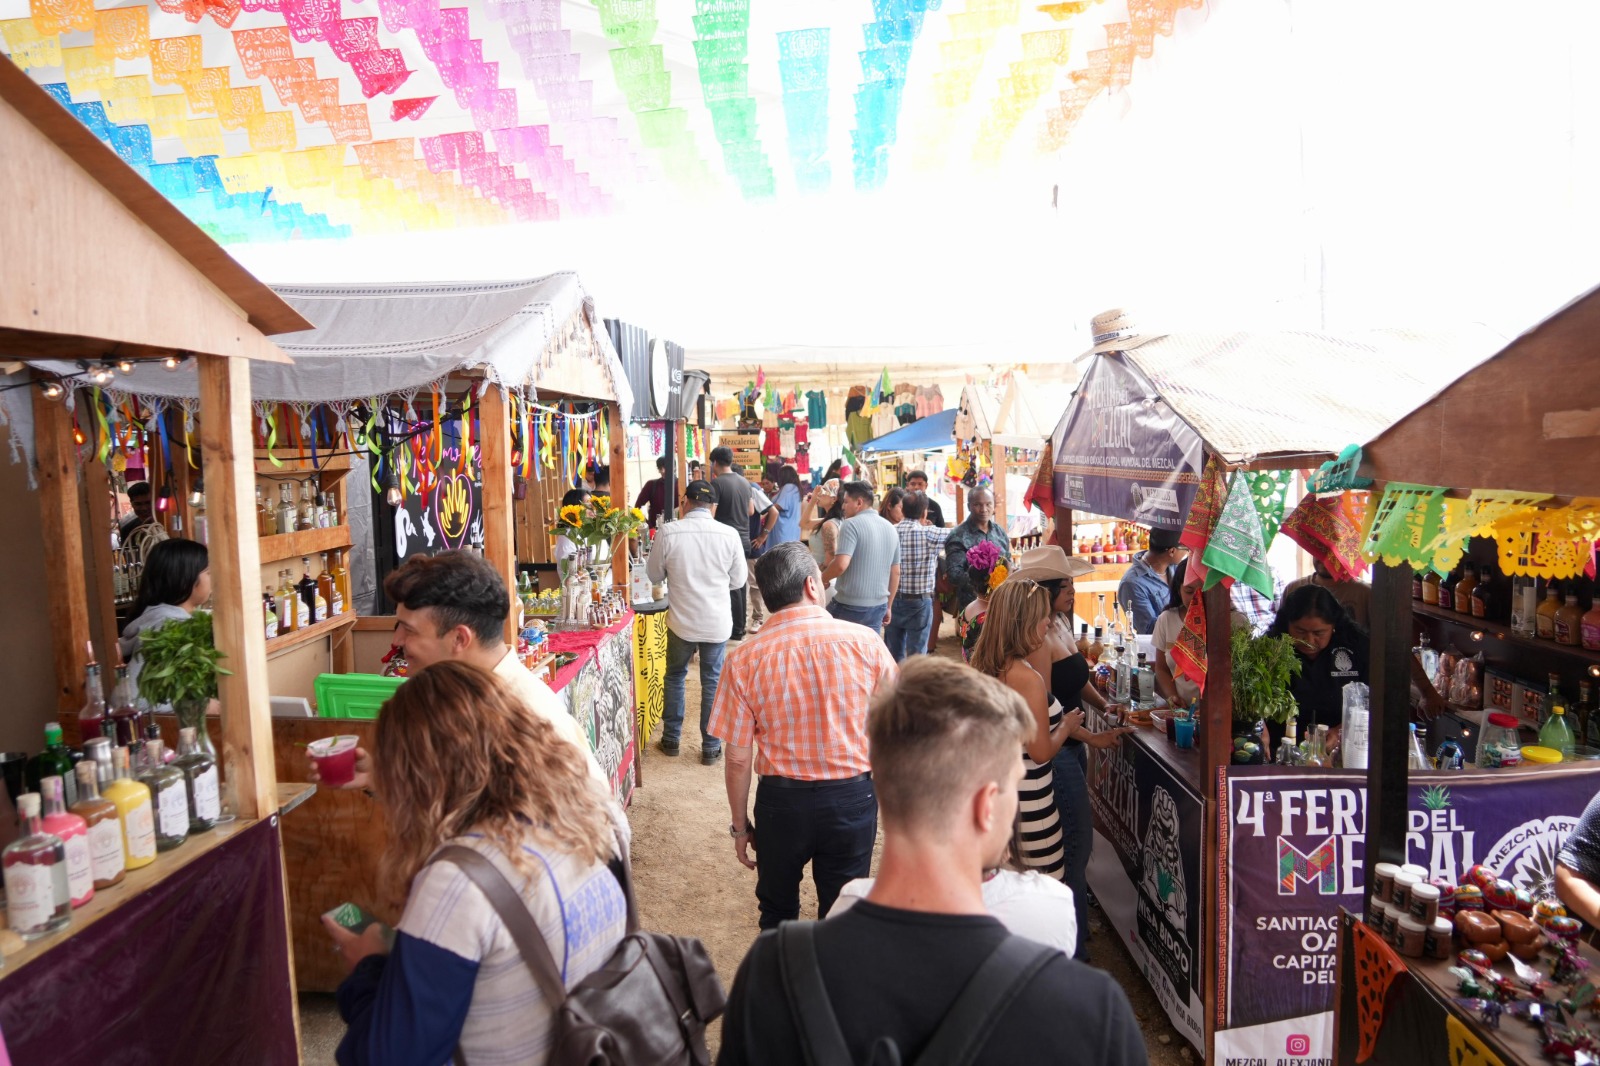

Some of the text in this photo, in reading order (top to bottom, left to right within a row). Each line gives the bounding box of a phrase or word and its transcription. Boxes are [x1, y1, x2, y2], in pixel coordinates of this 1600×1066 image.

[1141, 458, 1152, 468] DEL
[1152, 457, 1176, 469] MEZCAL
[1279, 788, 1368, 836] FERI
[1408, 809, 1465, 832] DEL
[1489, 822, 1576, 870] MEZCAL ART
[1256, 916, 1338, 931] SANTIAG
[1272, 954, 1336, 969] CAPITA
[1303, 970, 1336, 984] DEL
